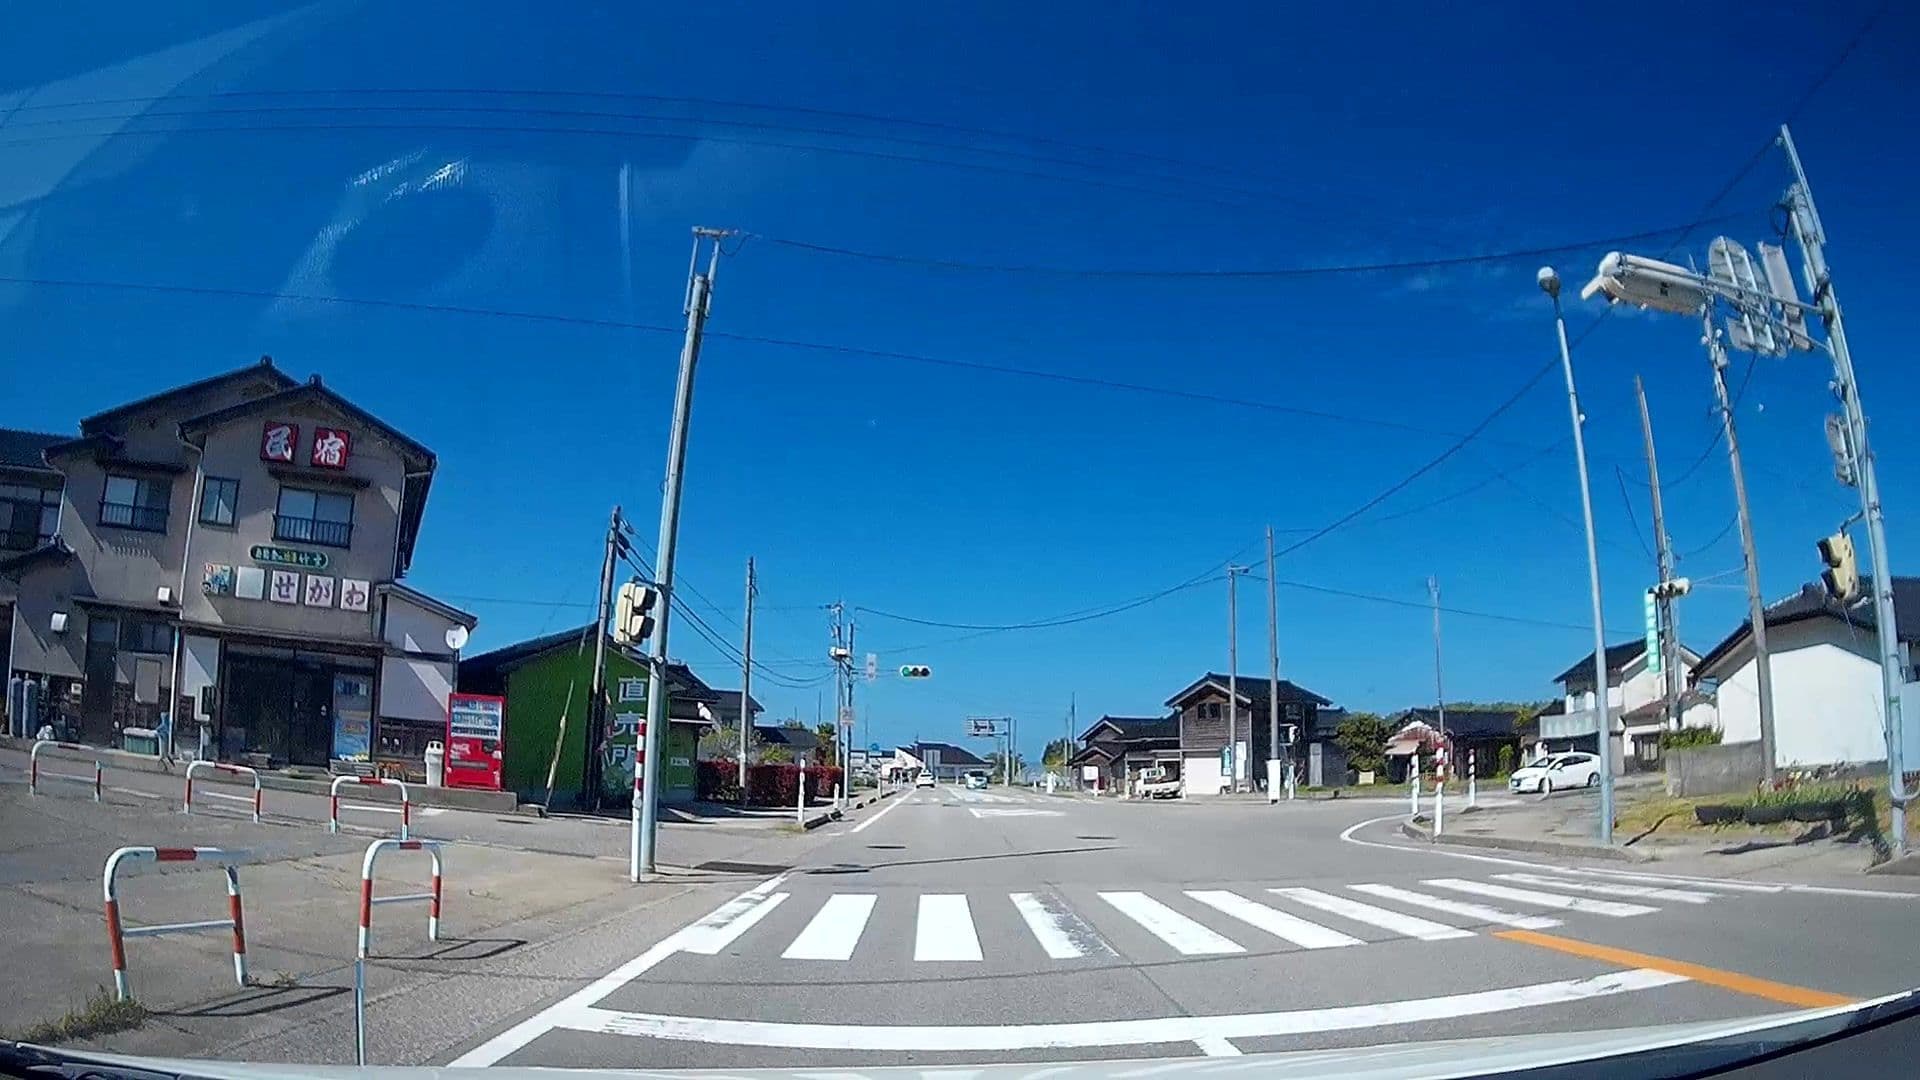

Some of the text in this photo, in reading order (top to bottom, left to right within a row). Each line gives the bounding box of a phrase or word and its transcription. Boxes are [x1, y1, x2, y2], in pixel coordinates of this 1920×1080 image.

[266, 425, 346, 465] 民宿
[274, 573, 366, 607] せがわ
